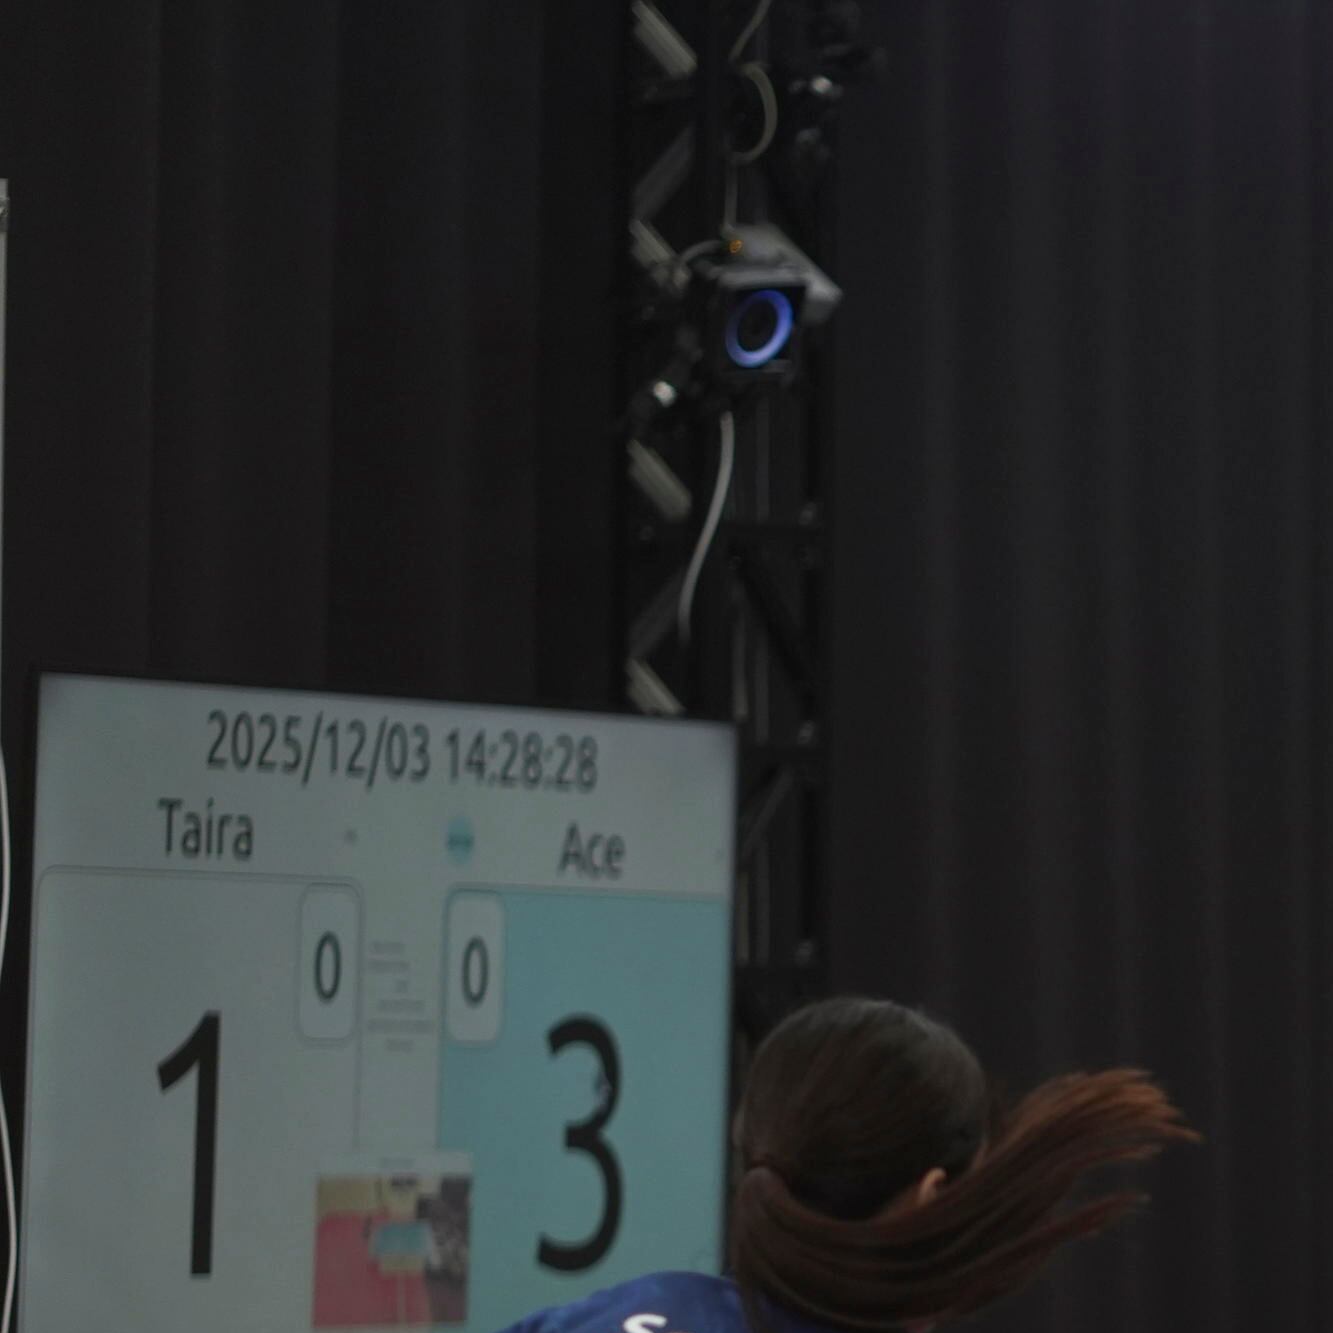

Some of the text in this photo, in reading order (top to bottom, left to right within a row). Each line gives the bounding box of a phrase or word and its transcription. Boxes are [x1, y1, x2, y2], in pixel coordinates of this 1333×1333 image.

[207, 709, 600, 793] 2025/12/03 14:28:28
[159, 798, 253, 861] Taira
[558, 821, 626, 880] Ace
[313, 931, 342, 1004] 0
[461, 935, 489, 1008] 0
[158, 1008, 220, 1276] 1
[537, 1012, 623, 1272] 3
